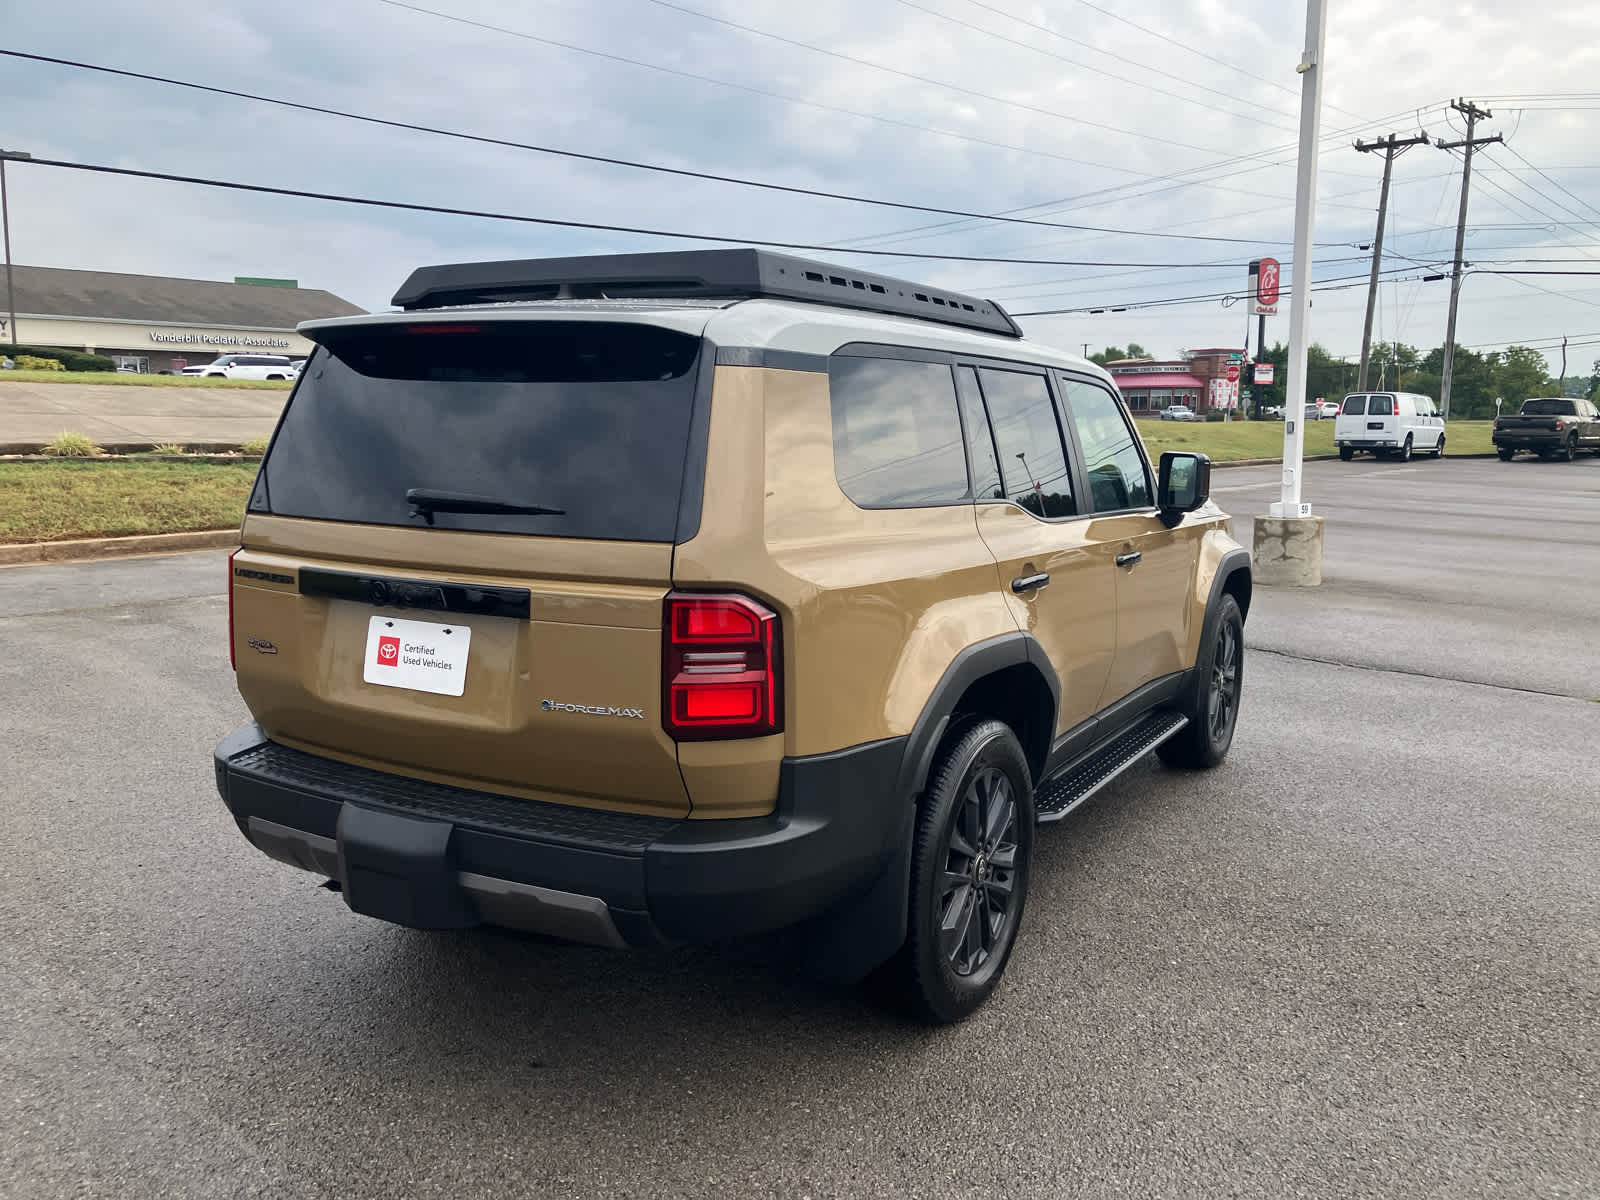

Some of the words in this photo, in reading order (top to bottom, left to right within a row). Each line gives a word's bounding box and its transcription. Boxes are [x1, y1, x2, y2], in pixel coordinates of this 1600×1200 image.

[203, 334, 243, 345] Pediatric
[404, 643, 435, 656] Certified
[403, 655, 421, 666] Used
[422, 658, 452, 670] Vehicles
